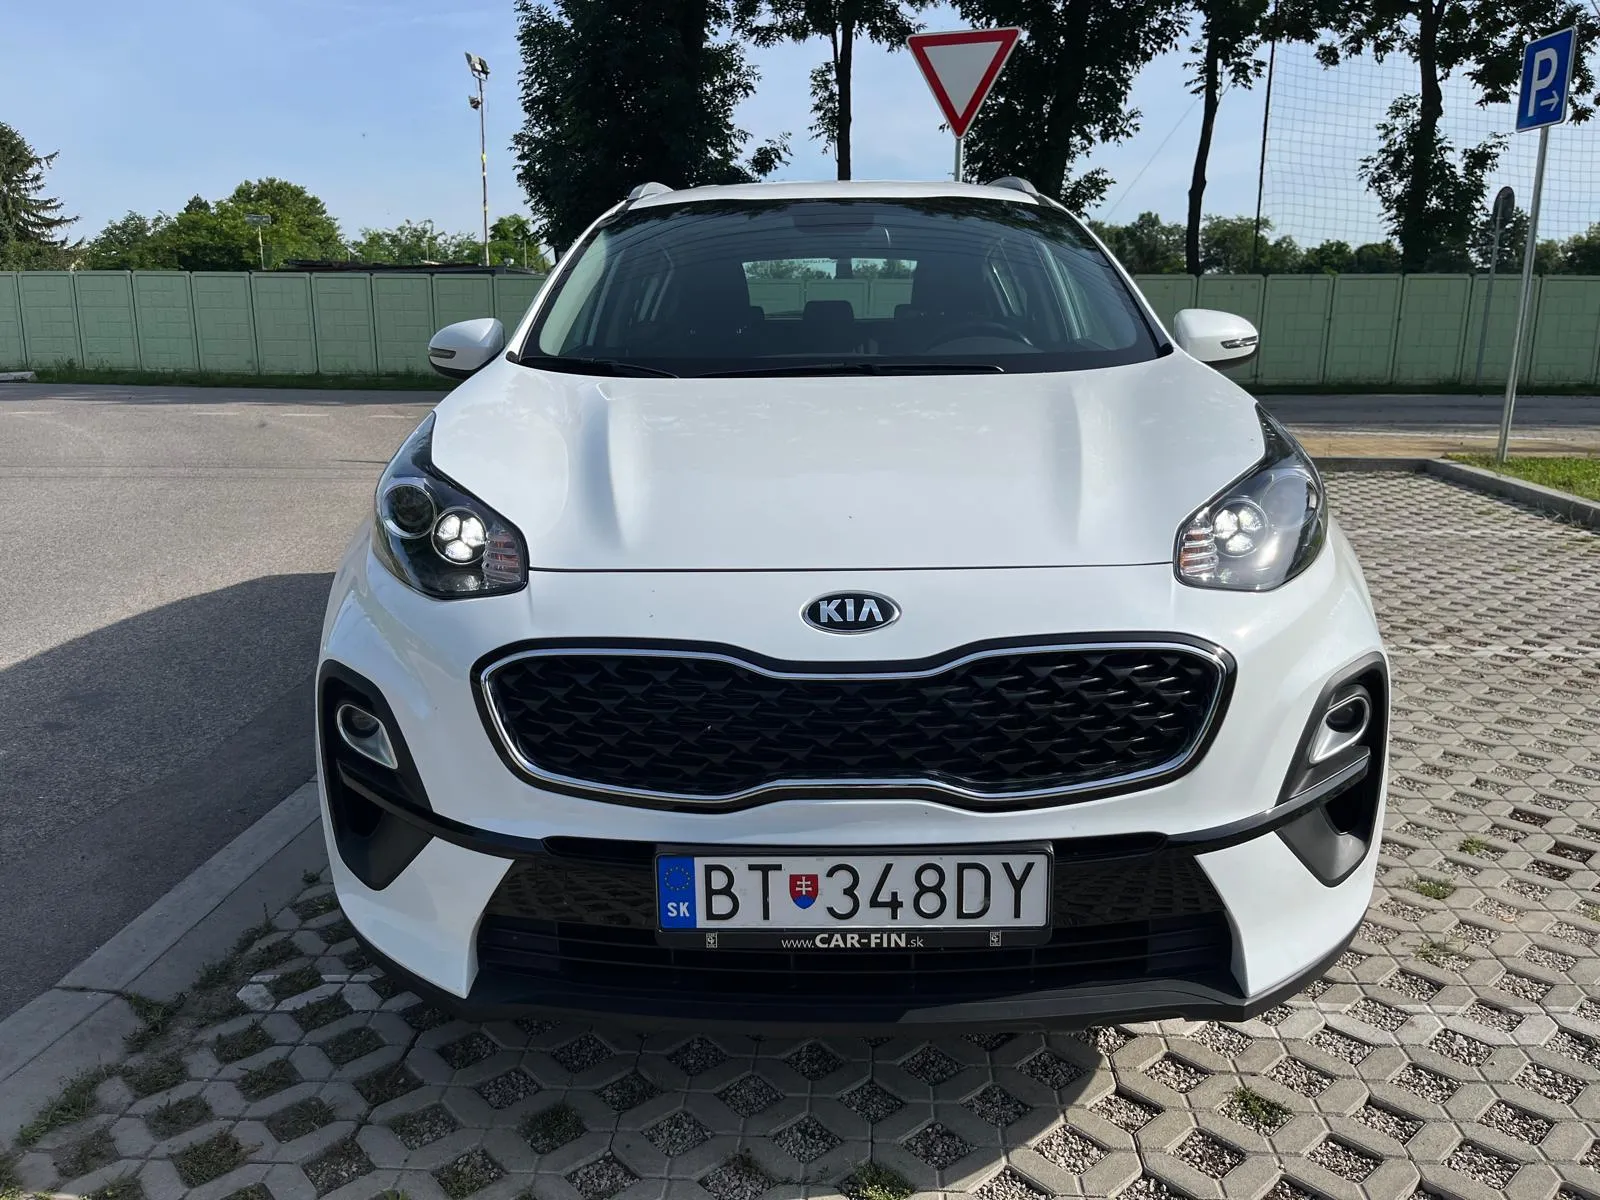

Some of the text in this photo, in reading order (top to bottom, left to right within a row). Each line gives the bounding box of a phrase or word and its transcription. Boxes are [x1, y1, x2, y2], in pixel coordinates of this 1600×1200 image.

[1527, 47, 1558, 118] P
[818, 598, 884, 623] KIA
[704, 862, 1036, 921] BT 348DY
[666, 901, 690, 918] SK
[781, 932, 925, 949] www.CAR-FIN.sk
